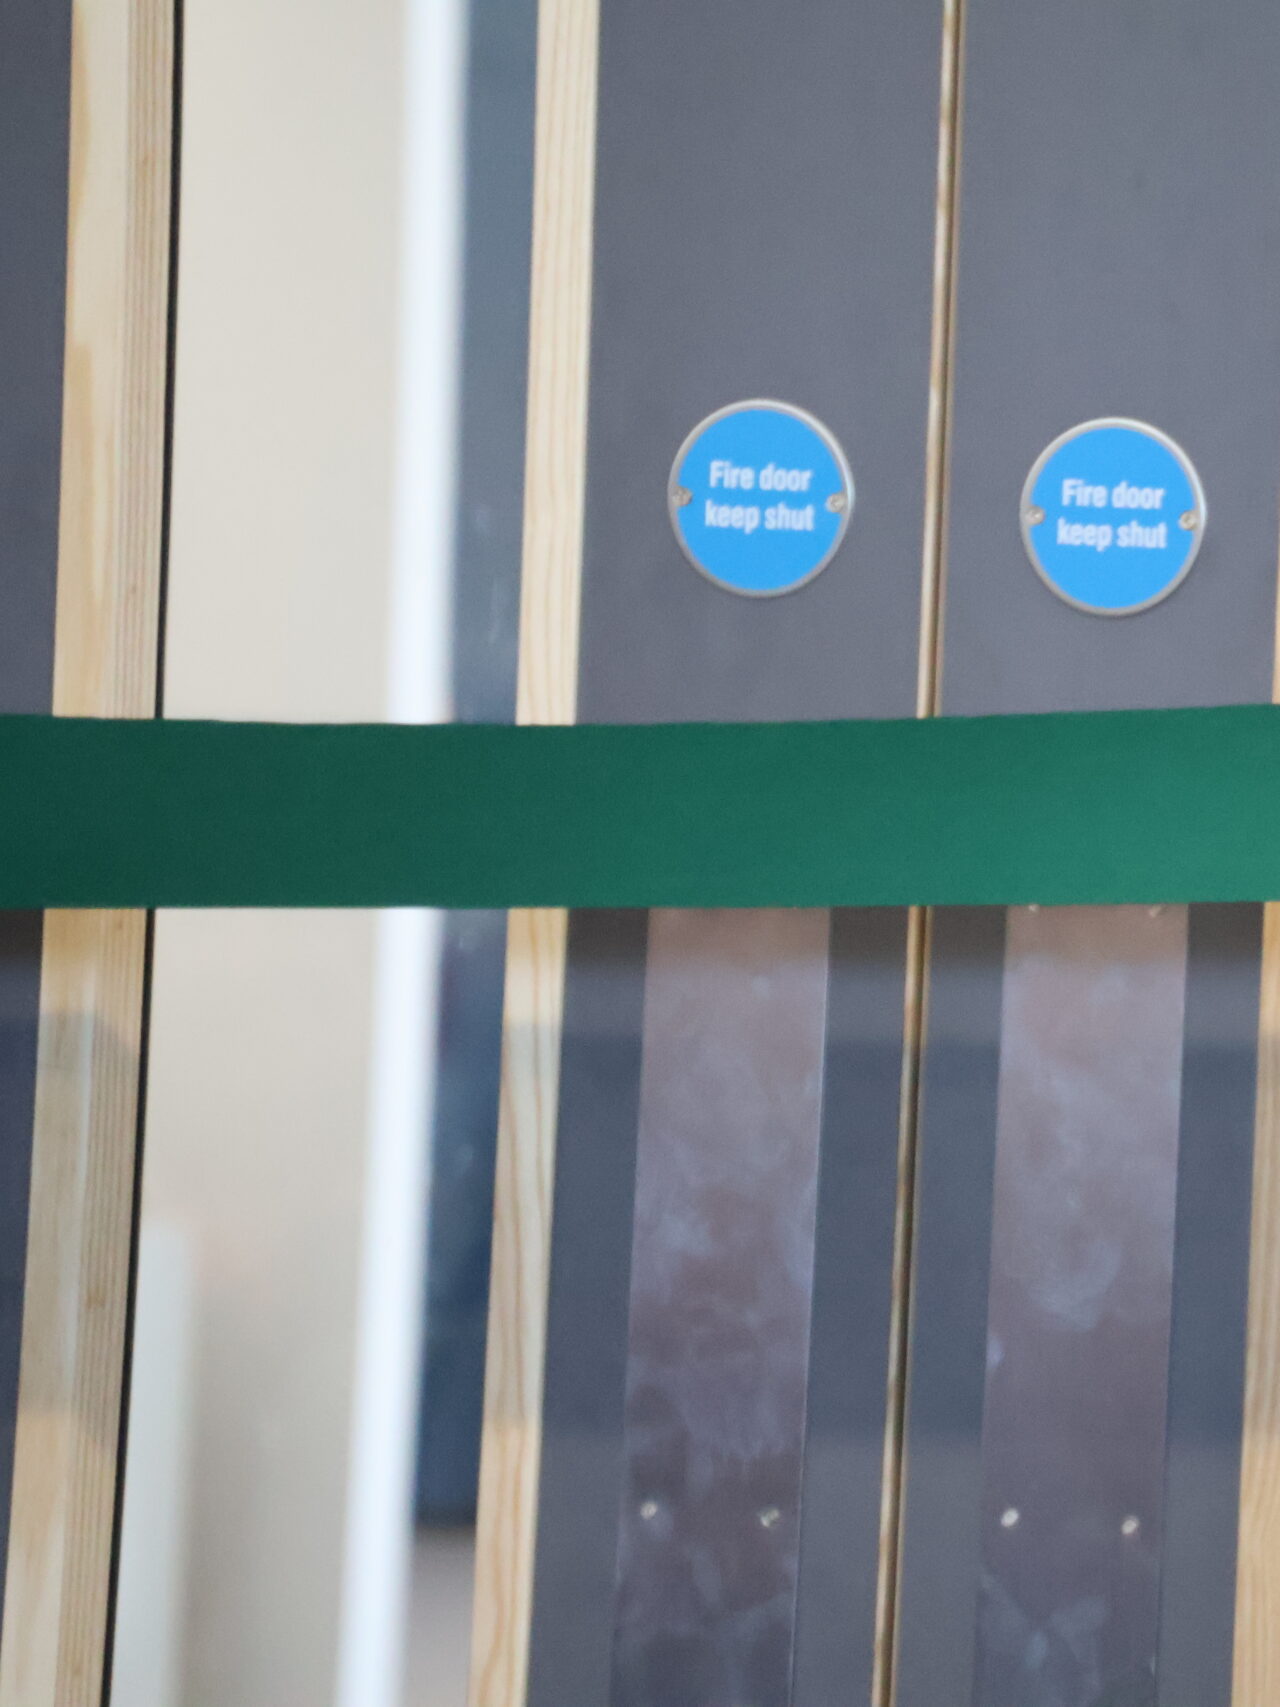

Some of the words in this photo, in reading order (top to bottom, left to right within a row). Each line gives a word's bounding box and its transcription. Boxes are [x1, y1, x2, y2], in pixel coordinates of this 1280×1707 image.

[709, 460, 755, 490] Fire
[760, 464, 812, 492] door
[1062, 478, 1108, 508] Fire
[1112, 482, 1165, 510] door
[705, 500, 760, 534] keep
[764, 503, 815, 531] shut
[1056, 517, 1113, 552] keep
[1117, 521, 1168, 549] shut
